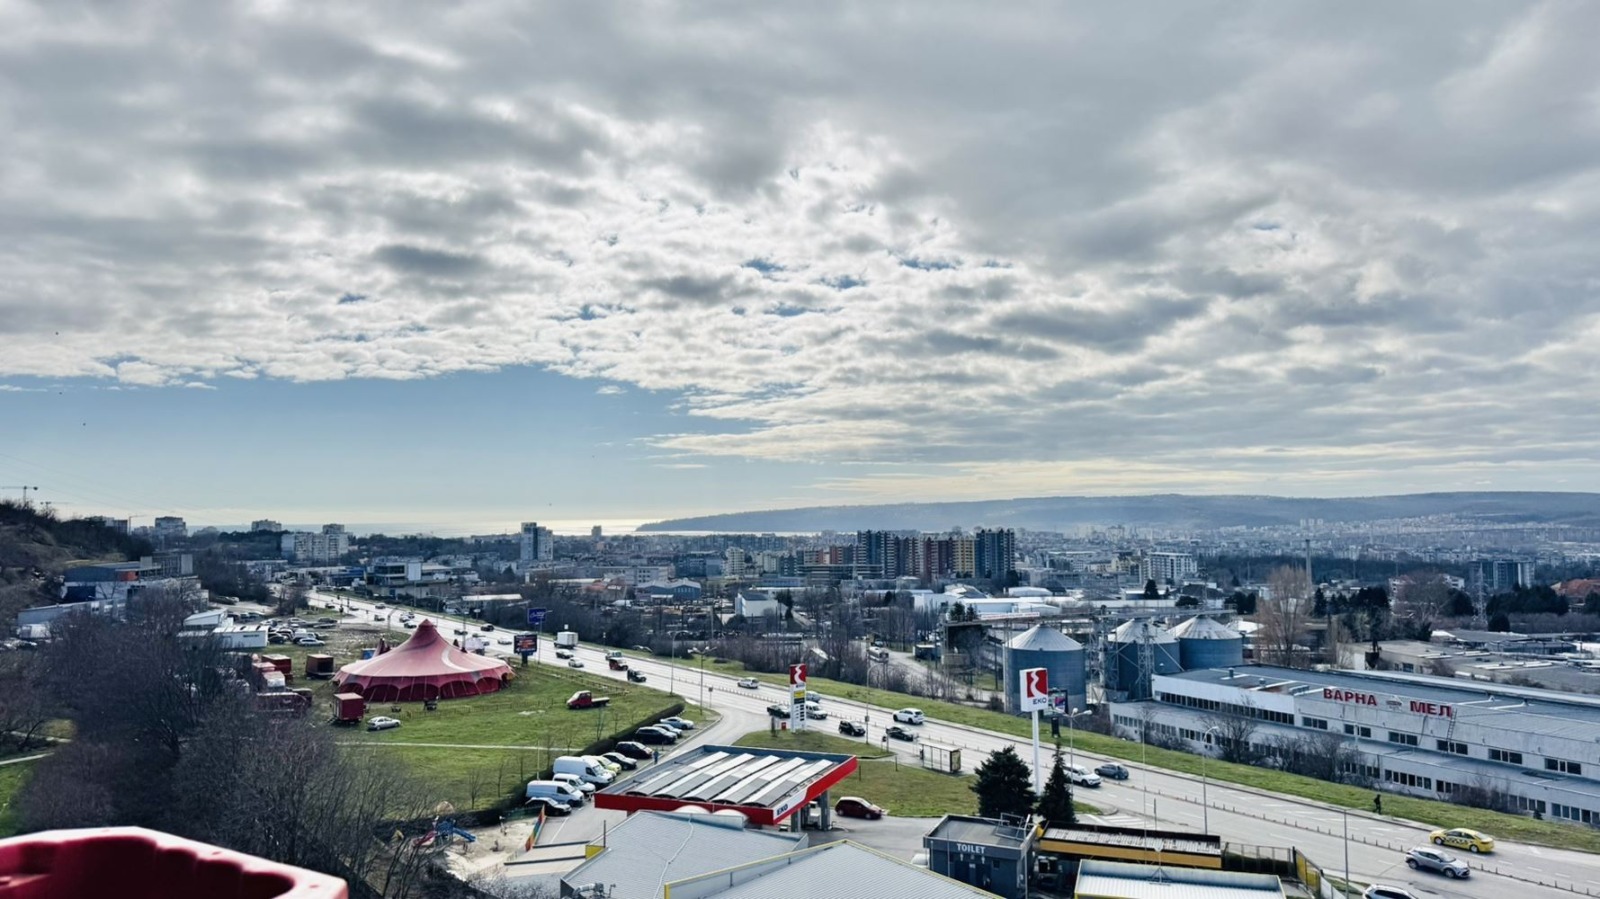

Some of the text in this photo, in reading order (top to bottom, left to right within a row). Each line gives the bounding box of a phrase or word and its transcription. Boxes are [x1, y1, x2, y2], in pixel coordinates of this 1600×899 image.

[1033, 697, 1047, 705] EKO
[1323, 688, 1453, 717] ВАРНА МЕЛ
[777, 803, 788, 815] EKO
[957, 843, 985, 854] TOILET
